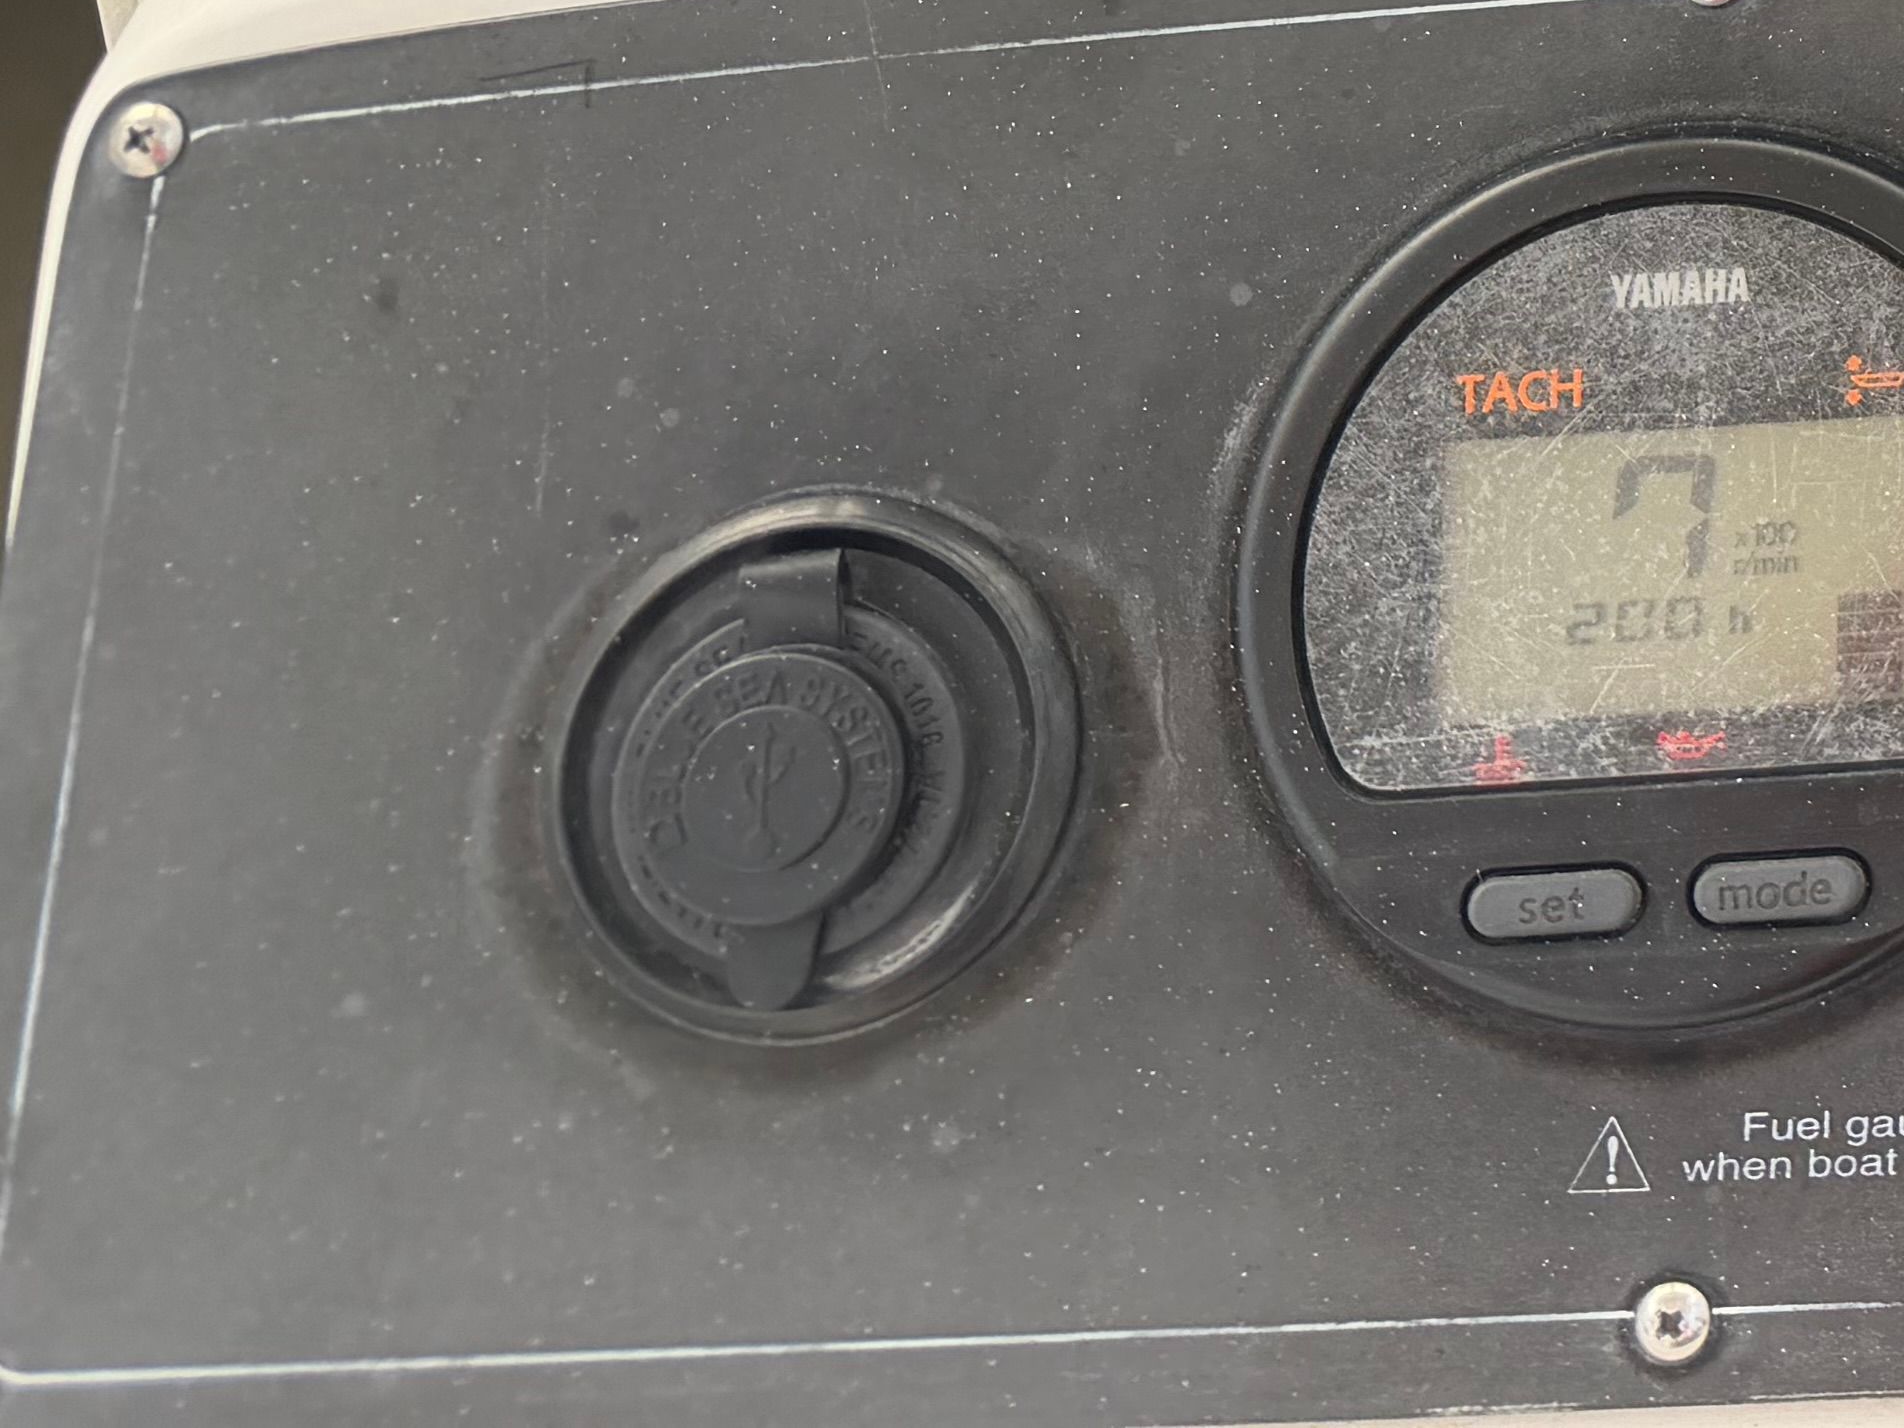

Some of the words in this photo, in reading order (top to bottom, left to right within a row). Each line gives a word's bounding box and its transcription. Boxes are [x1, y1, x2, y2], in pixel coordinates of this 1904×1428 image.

[1610, 267, 1750, 309] YAMAHA
[1457, 369, 1584, 414] TACH
[1613, 453, 1717, 580] 7
[1518, 885, 1586, 925] set
[1717, 870, 1833, 912] mode
[1744, 1110, 1831, 1142] Fuel
[1683, 1152, 1791, 1181] when
[1808, 1148, 1898, 1178] boat
